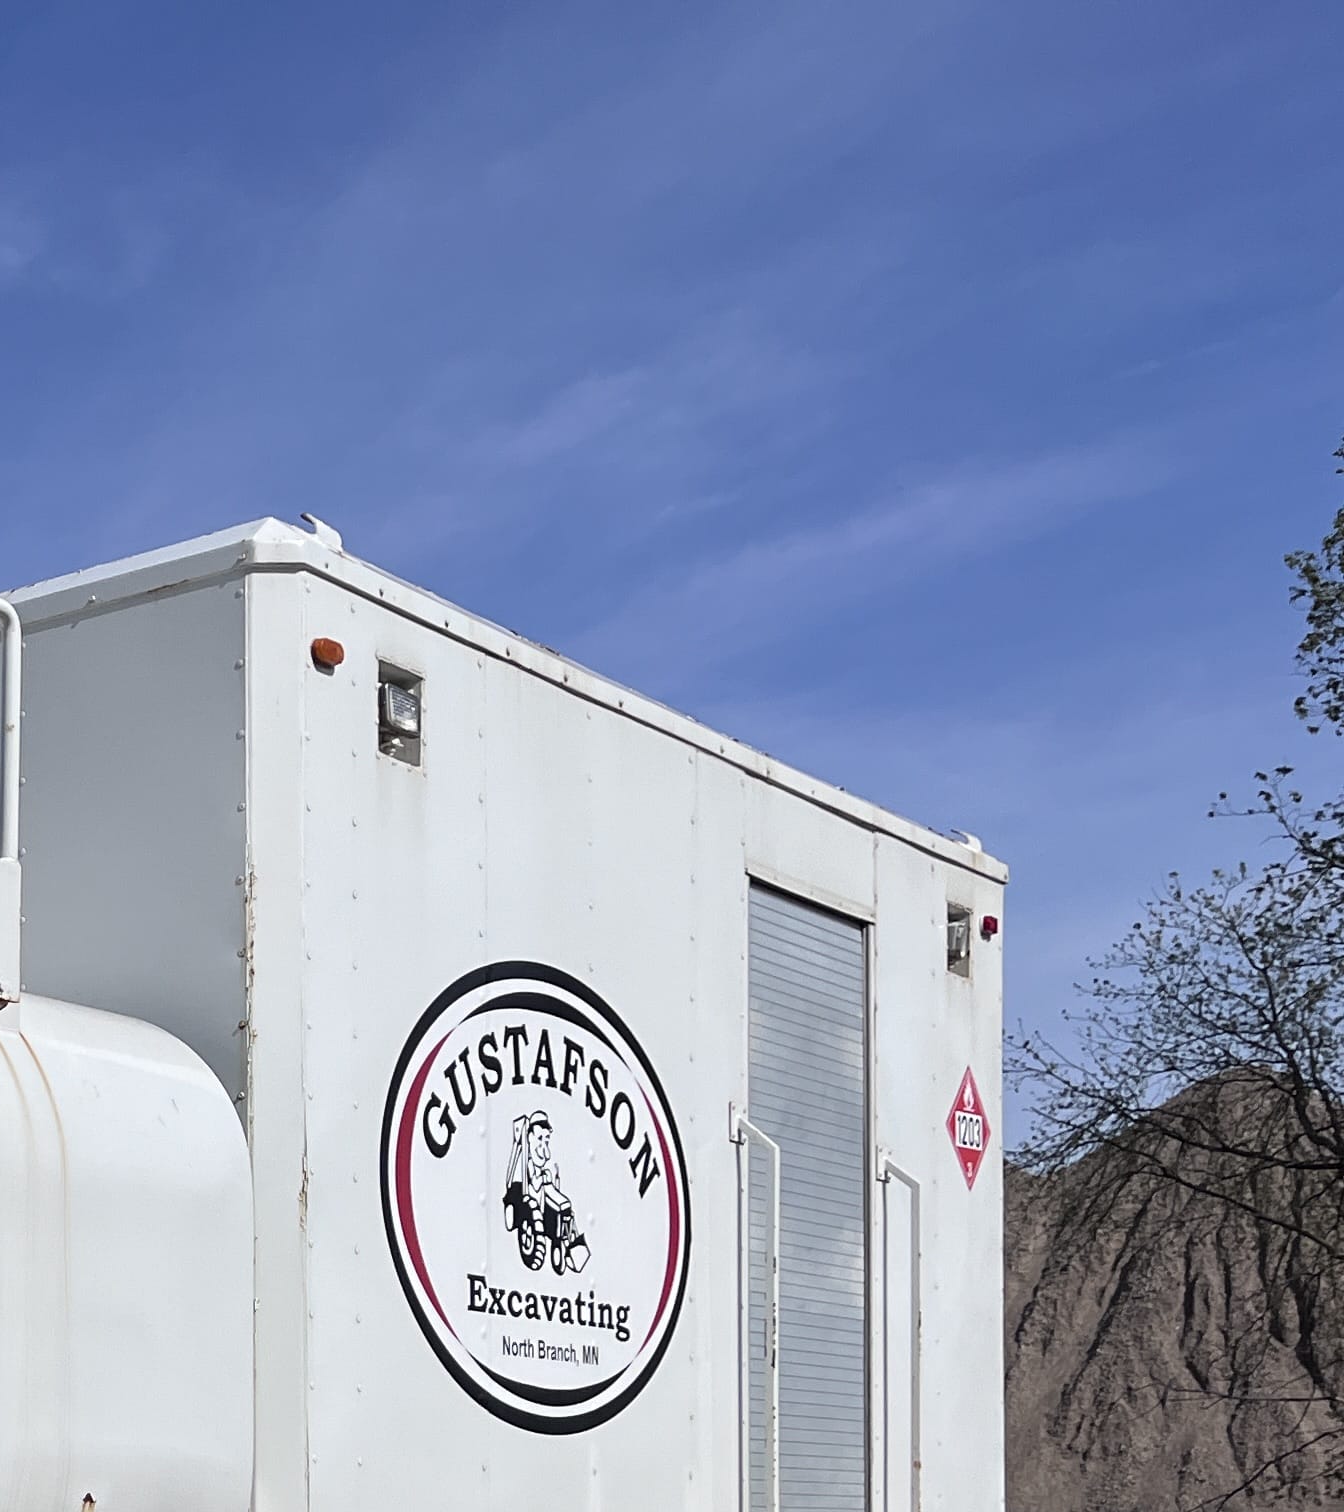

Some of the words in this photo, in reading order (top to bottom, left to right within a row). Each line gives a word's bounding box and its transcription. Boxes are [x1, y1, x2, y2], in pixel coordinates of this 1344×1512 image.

[423, 1024, 660, 1199] GUSTAFSON
[957, 1115, 981, 1148] 1203
[467, 1274, 630, 1342] Excavating
[502, 1335, 534, 1358] North
[538, 1340, 579, 1366] Branch,
[583, 1345, 599, 1365] MN
